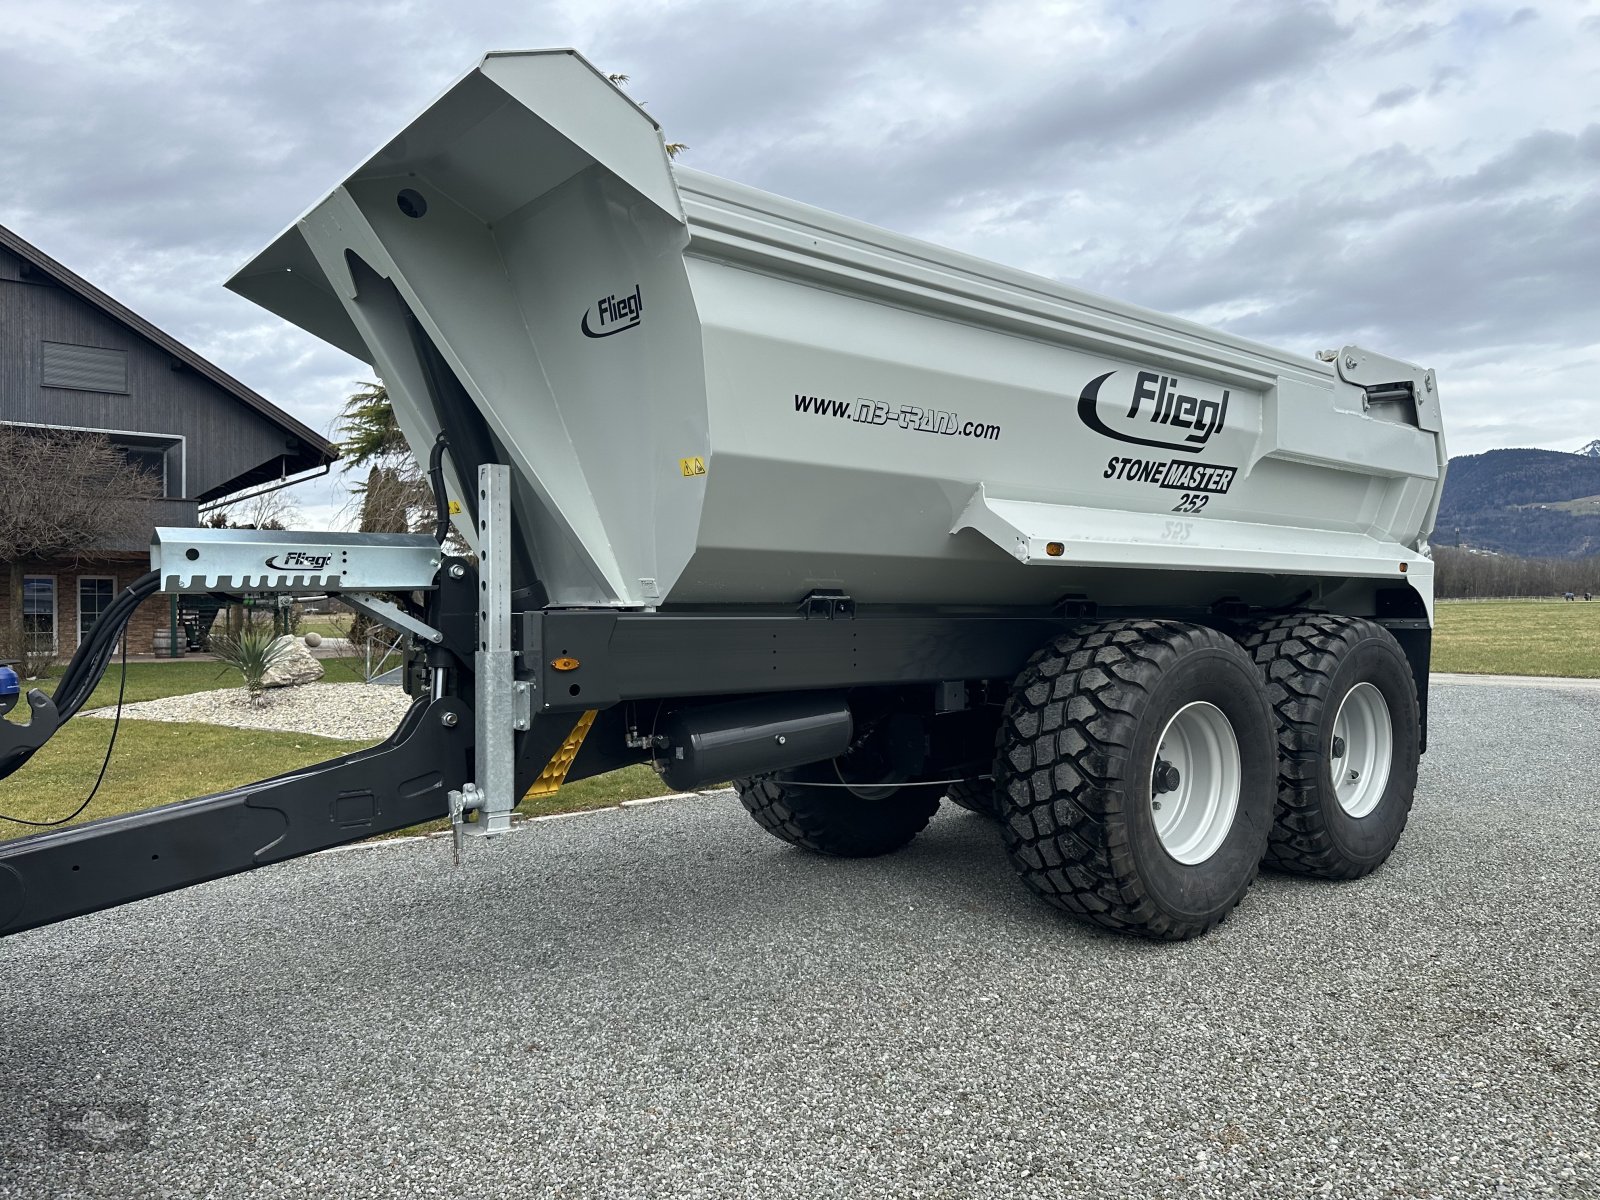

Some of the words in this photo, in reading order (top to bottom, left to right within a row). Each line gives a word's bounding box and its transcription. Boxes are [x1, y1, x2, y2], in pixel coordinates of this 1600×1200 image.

[598, 284, 642, 326] Fliegl
[1126, 371, 1230, 444] Fliegl
[1171, 493, 1210, 513] 252
[284, 552, 332, 568] Fliegl
